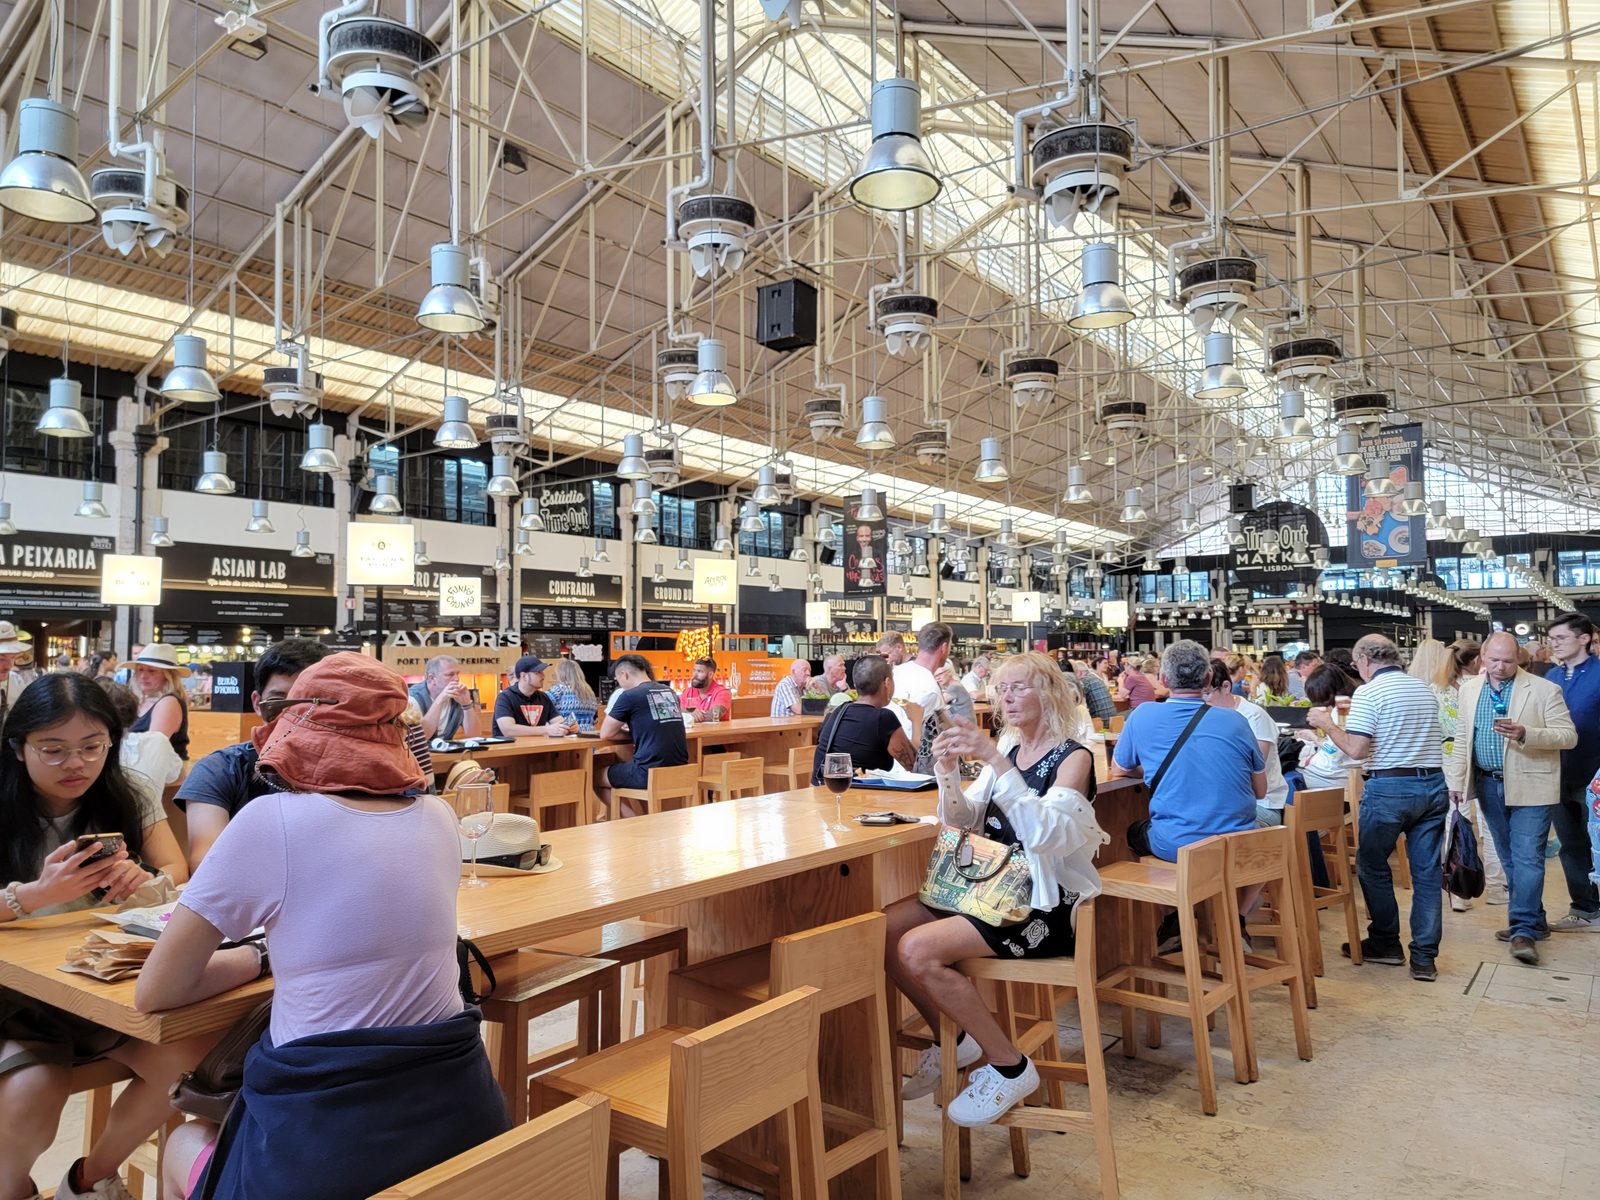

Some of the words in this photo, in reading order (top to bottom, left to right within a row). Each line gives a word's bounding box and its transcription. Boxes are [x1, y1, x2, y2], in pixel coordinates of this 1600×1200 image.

[540, 490, 586, 507] Estúdio
[12, 544, 97, 570] PEIXARIA
[1236, 551, 1321, 565] MARKT
[211, 557, 256, 578] ASIAN
[260, 560, 287, 580] LAB
[447, 585, 474, 596] FUNKY
[548, 580, 596, 597] CONFRARIA
[654, 586, 682, 600] GROUND
[446, 596, 475, 609] CHUNKY
[849, 632, 872, 643] CASA
[397, 657, 420, 666] PORT
[457, 657, 501, 665] PERIENCE
